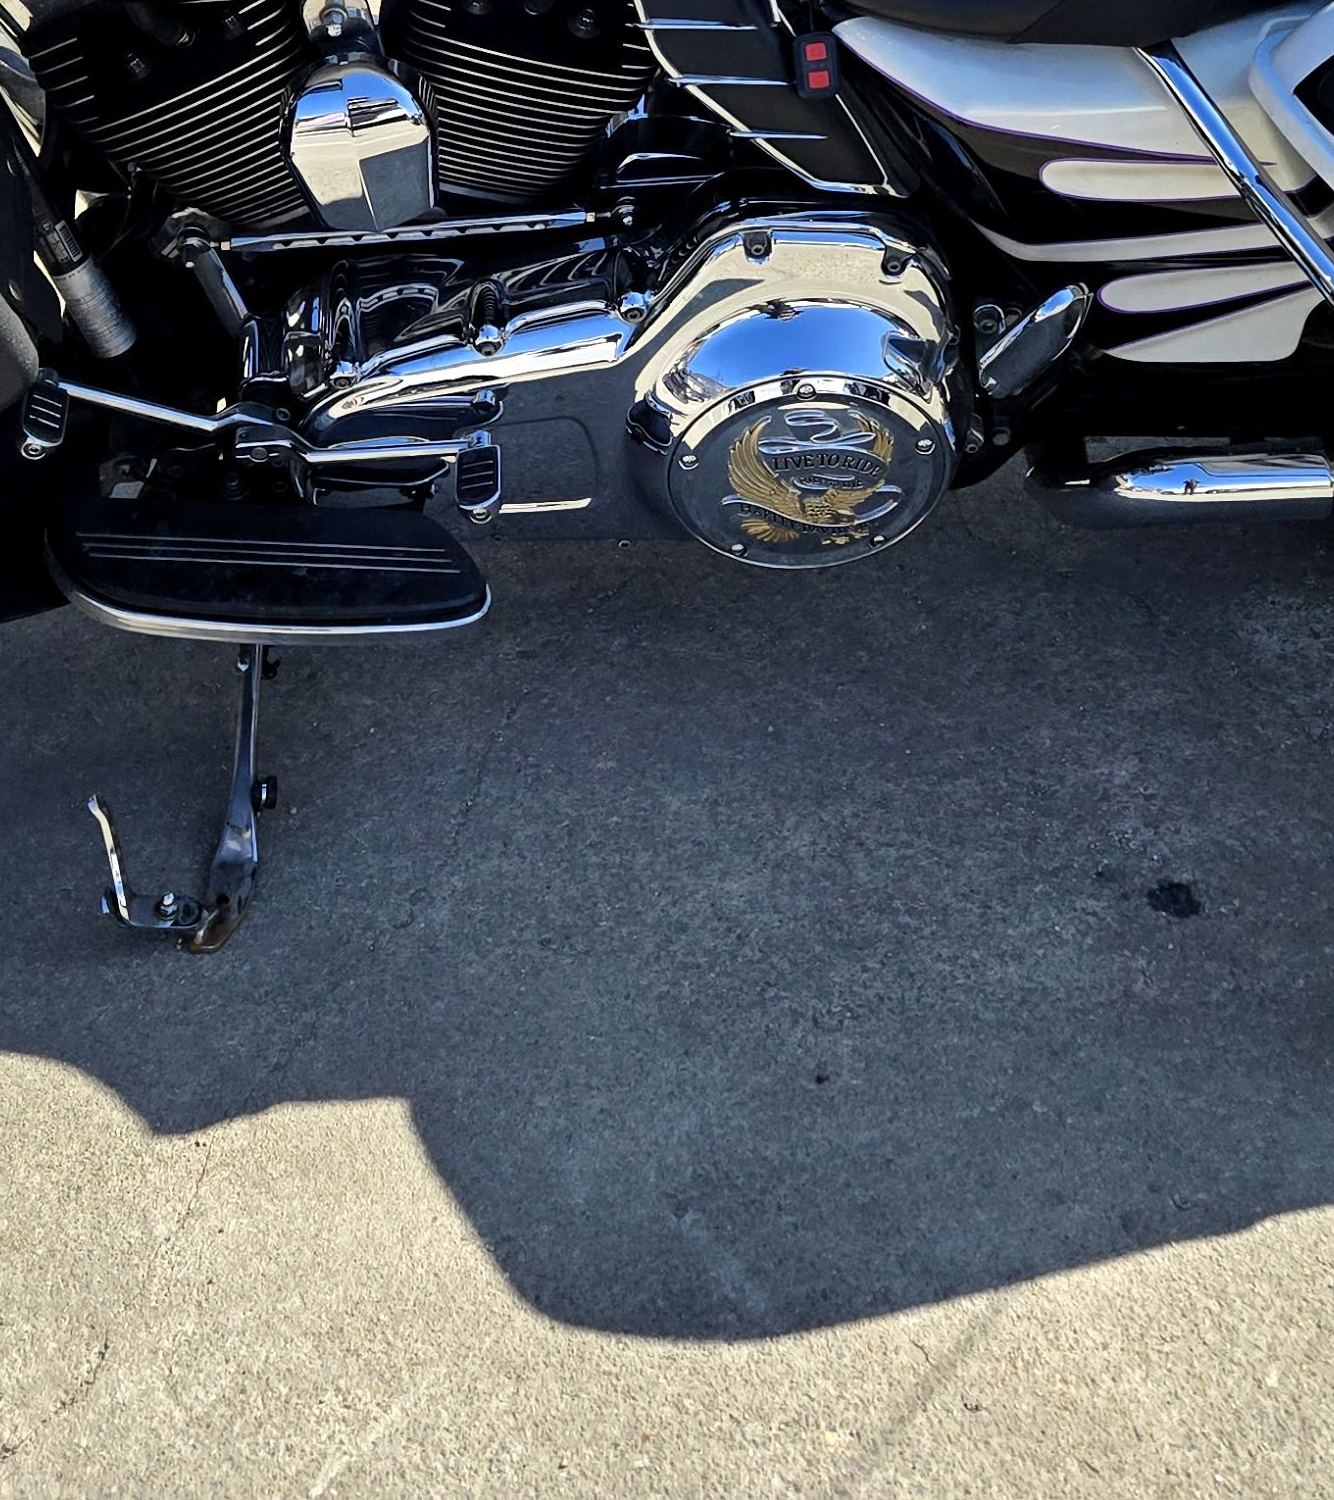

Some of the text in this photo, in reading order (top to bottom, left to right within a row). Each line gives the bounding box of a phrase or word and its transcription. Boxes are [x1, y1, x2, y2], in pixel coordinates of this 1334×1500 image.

[772, 454, 881, 478] LIVE TO RIDE
